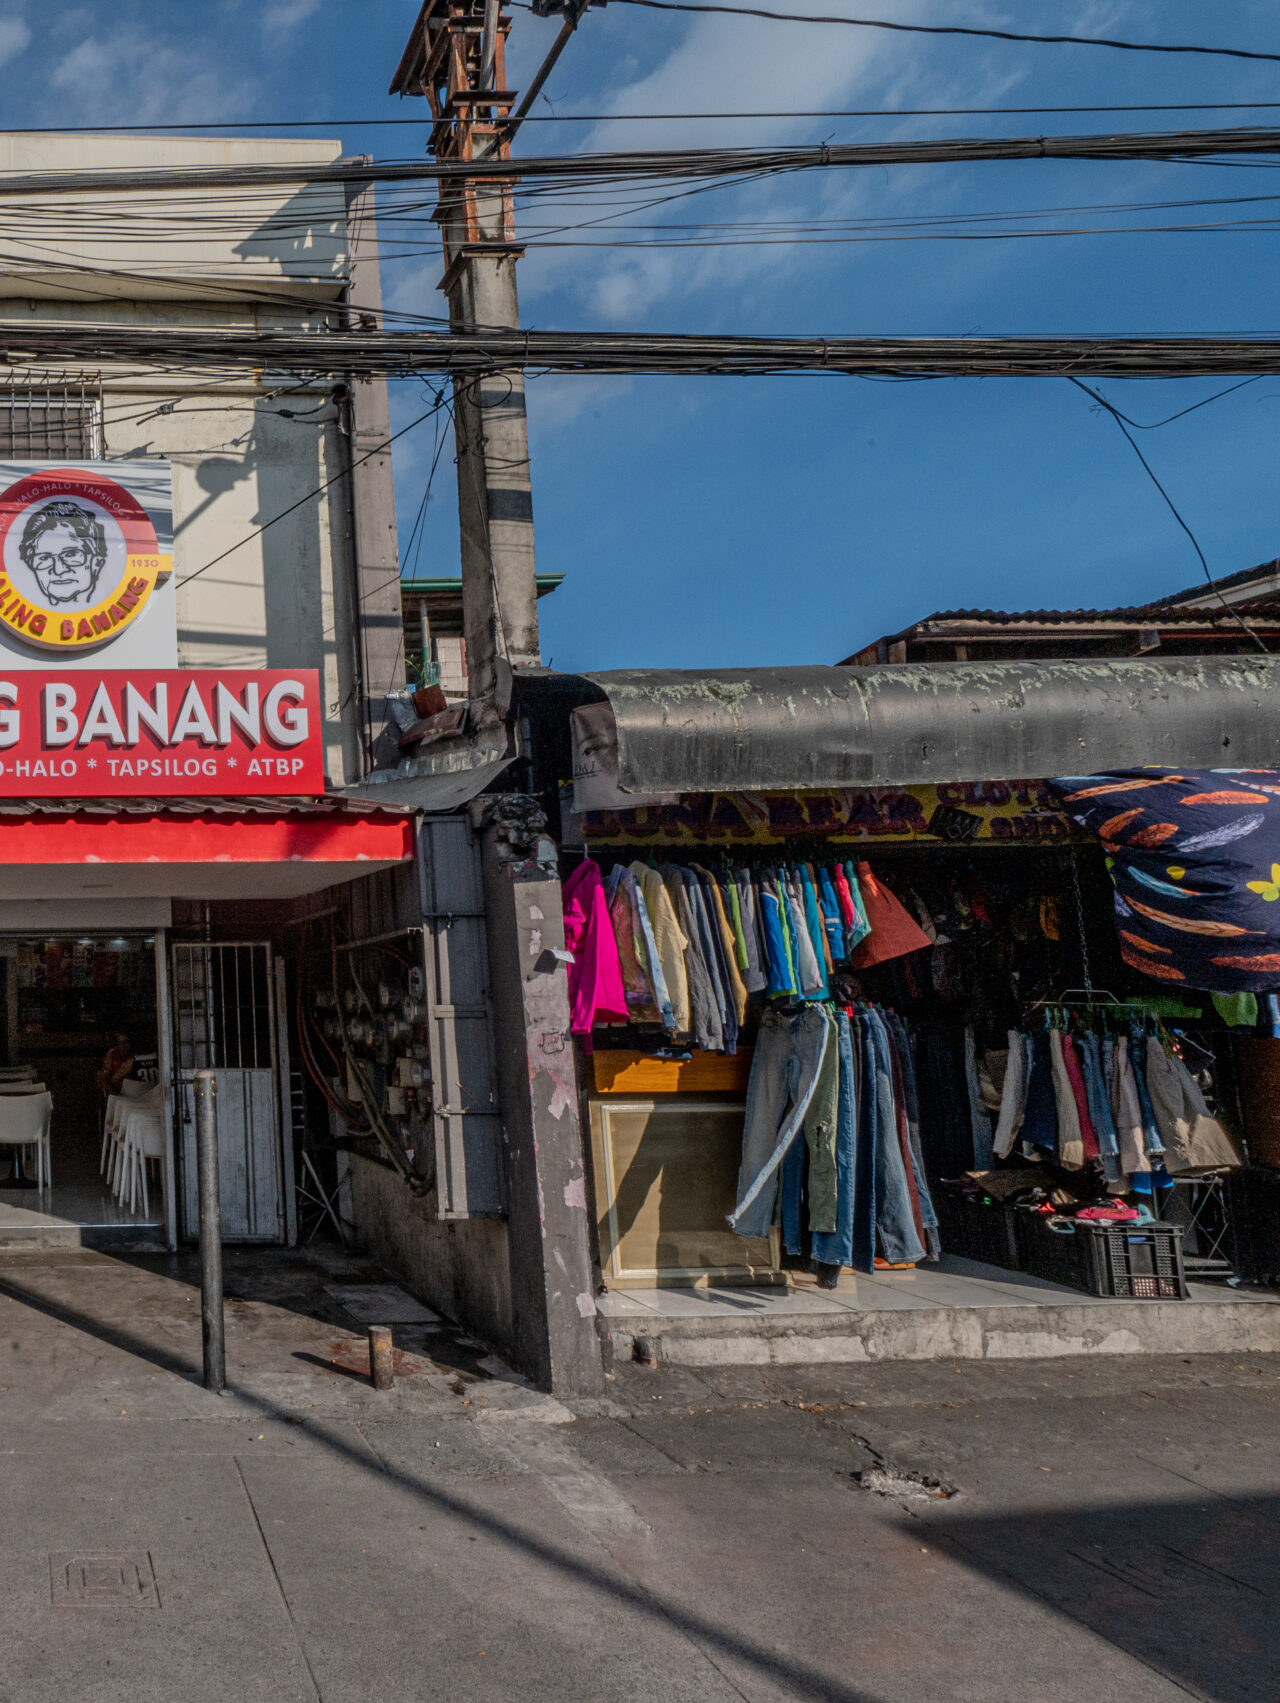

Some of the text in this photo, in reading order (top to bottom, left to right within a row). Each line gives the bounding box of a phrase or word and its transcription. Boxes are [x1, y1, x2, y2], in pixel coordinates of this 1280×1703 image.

[14, 482, 71, 508] HALO-HALO
[131, 559, 159, 568] 1930
[60, 576, 149, 641] BANANG
[45, 679, 309, 747] BANANG
[107, 758, 217, 776] TAPSILOG
[247, 757, 304, 776] ATBP
